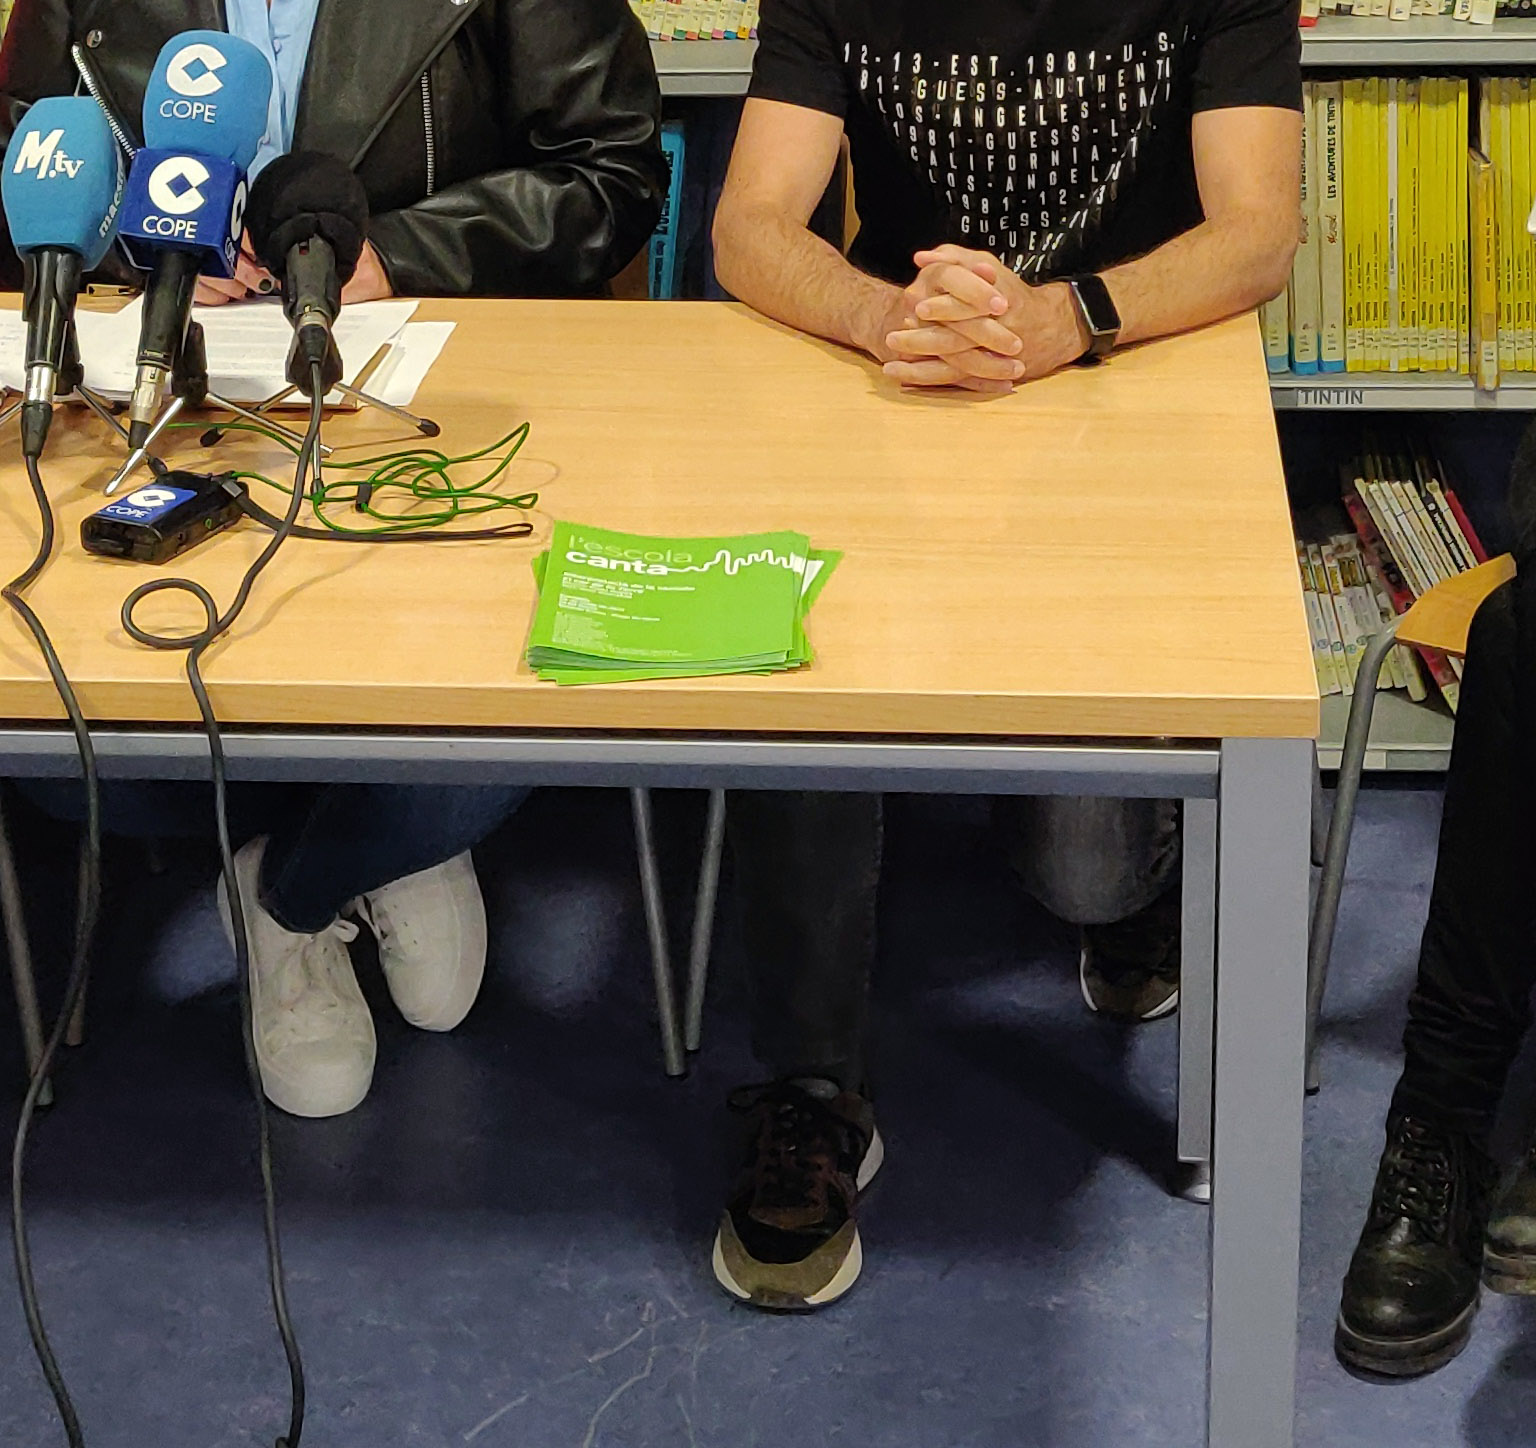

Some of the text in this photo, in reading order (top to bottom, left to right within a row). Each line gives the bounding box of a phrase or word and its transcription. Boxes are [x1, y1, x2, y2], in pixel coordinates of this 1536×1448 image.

[158, 99, 218, 124] COPE
[141, 214, 199, 239] COPE
[1299, 388, 1364, 406] TINTIN
[105, 505, 152, 519] COPE
[568, 534, 693, 564] l'escola
[565, 550, 669, 576] canta
